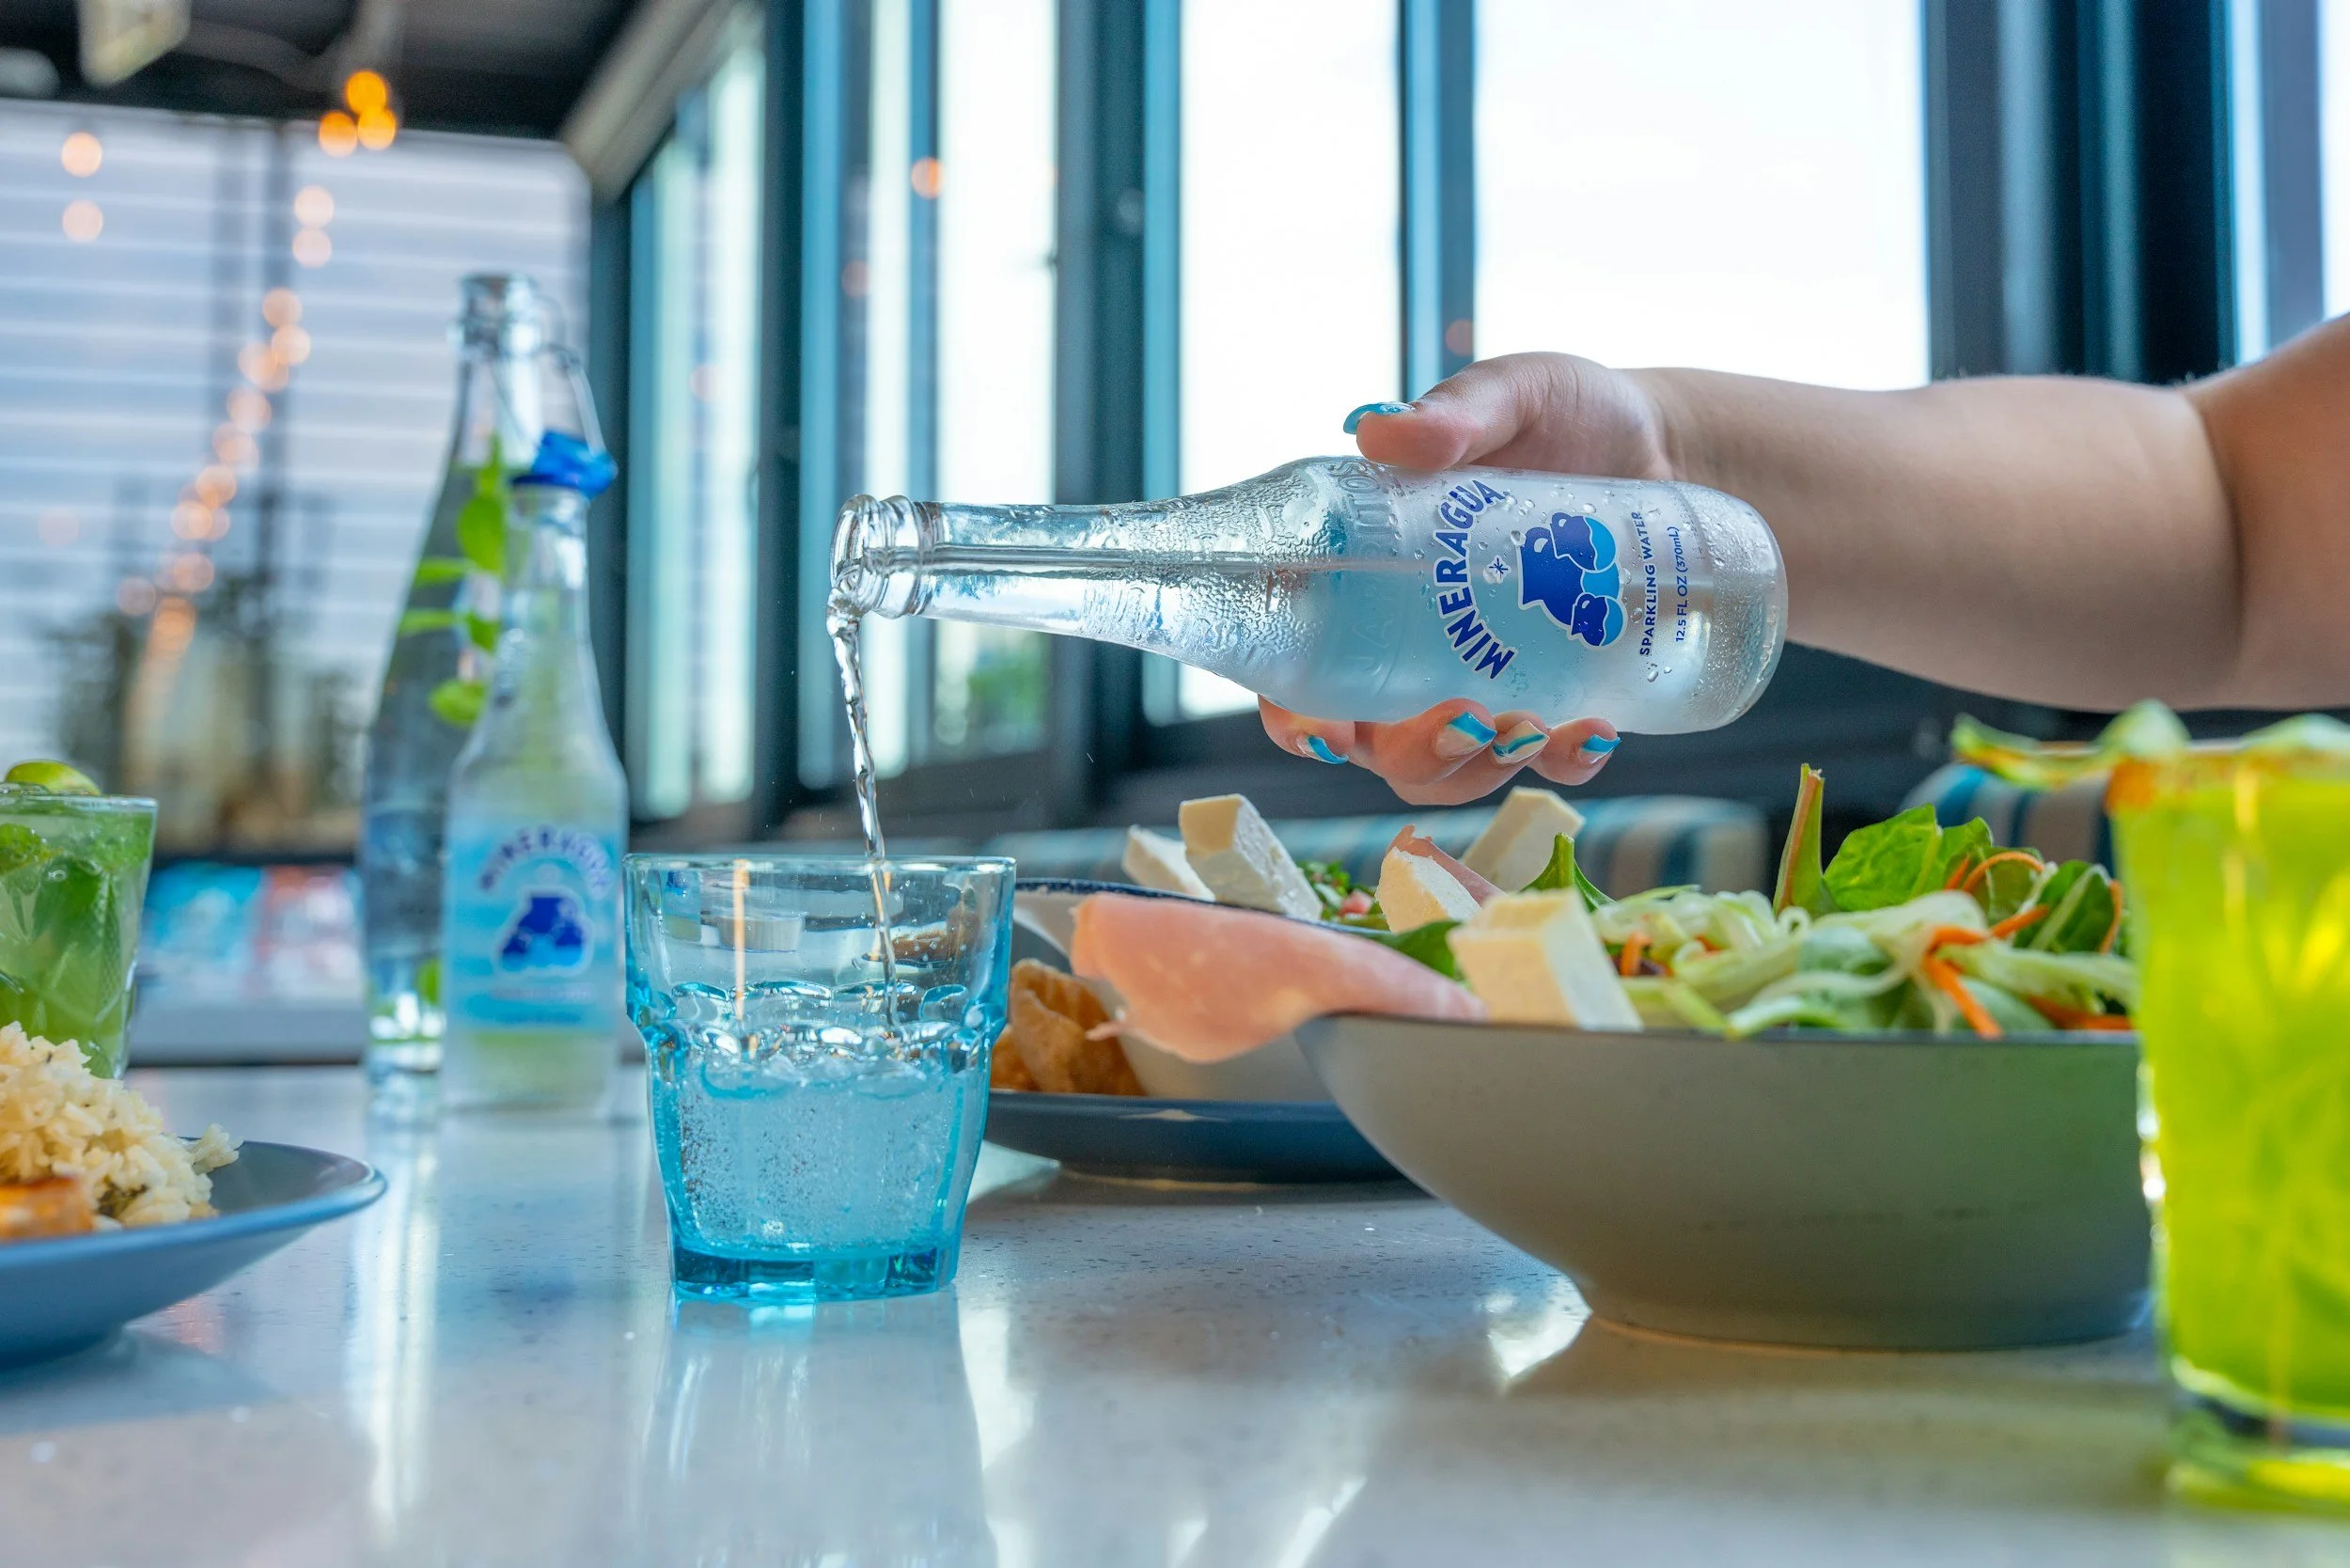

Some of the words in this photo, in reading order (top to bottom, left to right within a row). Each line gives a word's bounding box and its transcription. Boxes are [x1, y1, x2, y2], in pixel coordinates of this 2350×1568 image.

[1631, 511, 1653, 560] WATER
[1667, 526, 1688, 572] (370mL)
[1435, 479, 1515, 680] MINERAGUA
[1677, 575, 1688, 597] OZ
[1639, 564, 1657, 656] SPARKLING
[1675, 619, 1687, 642] 12.5
[1677, 599, 1688, 616] FL
